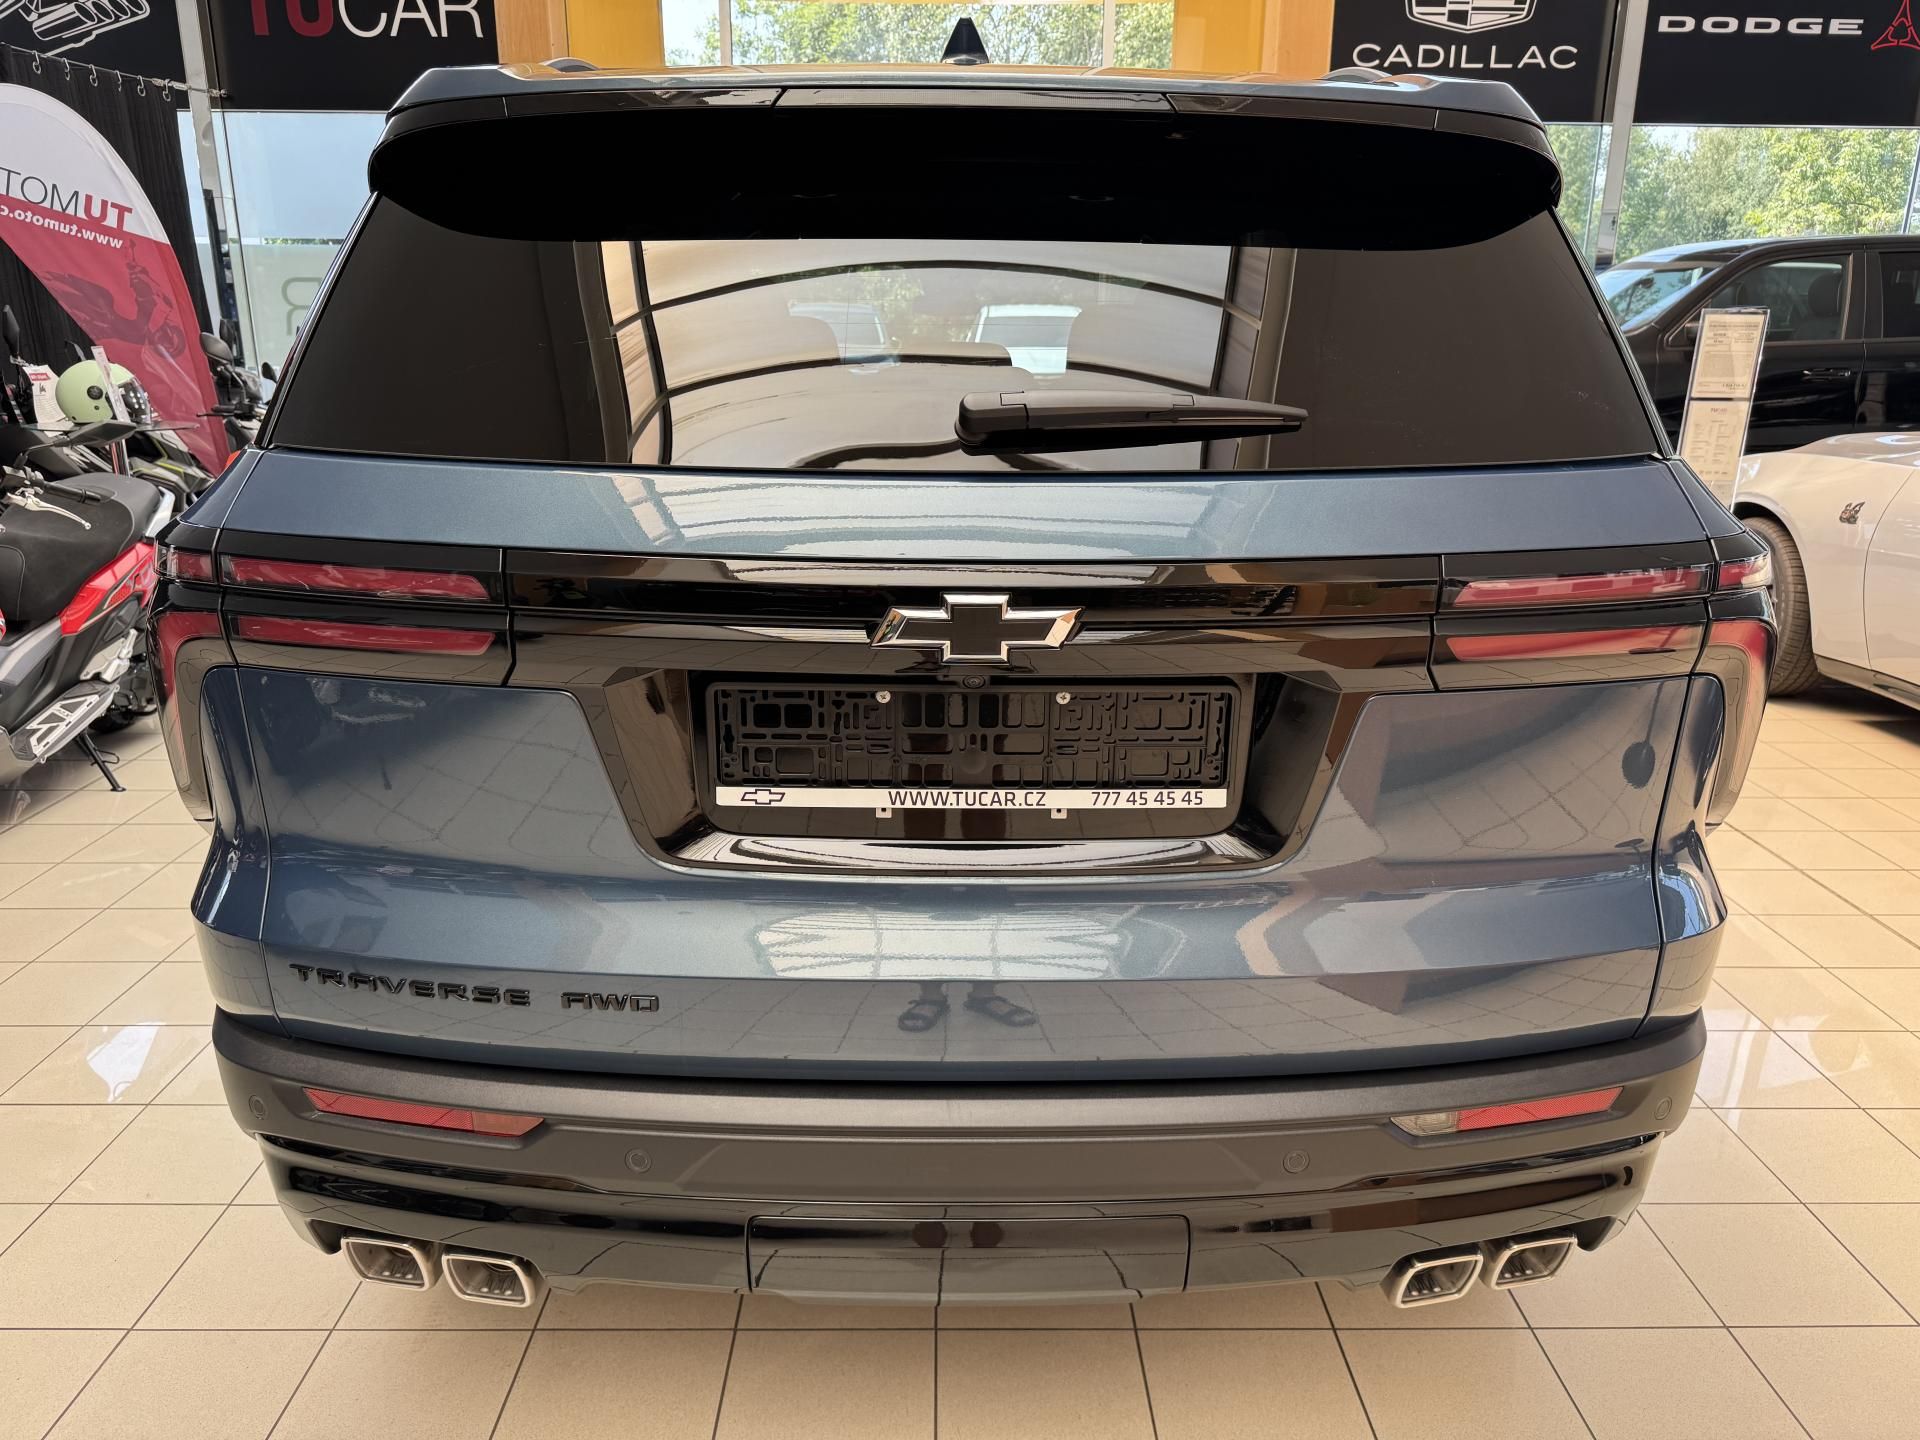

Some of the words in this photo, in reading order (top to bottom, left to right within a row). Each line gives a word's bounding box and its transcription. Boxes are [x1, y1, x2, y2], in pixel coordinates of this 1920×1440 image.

[1657, 15, 1864, 36] DODGE
[1352, 43, 1578, 70] CADILLAC
[888, 790, 1047, 807] WWW.TUCAR.CZ
[1091, 791, 1121, 806] 777
[1126, 791, 1148, 806] 45
[1153, 791, 1176, 806] 45
[1181, 790, 1204, 806] 45
[289, 963, 531, 1007] TRAVERSE
[560, 991, 660, 1013] AWD
